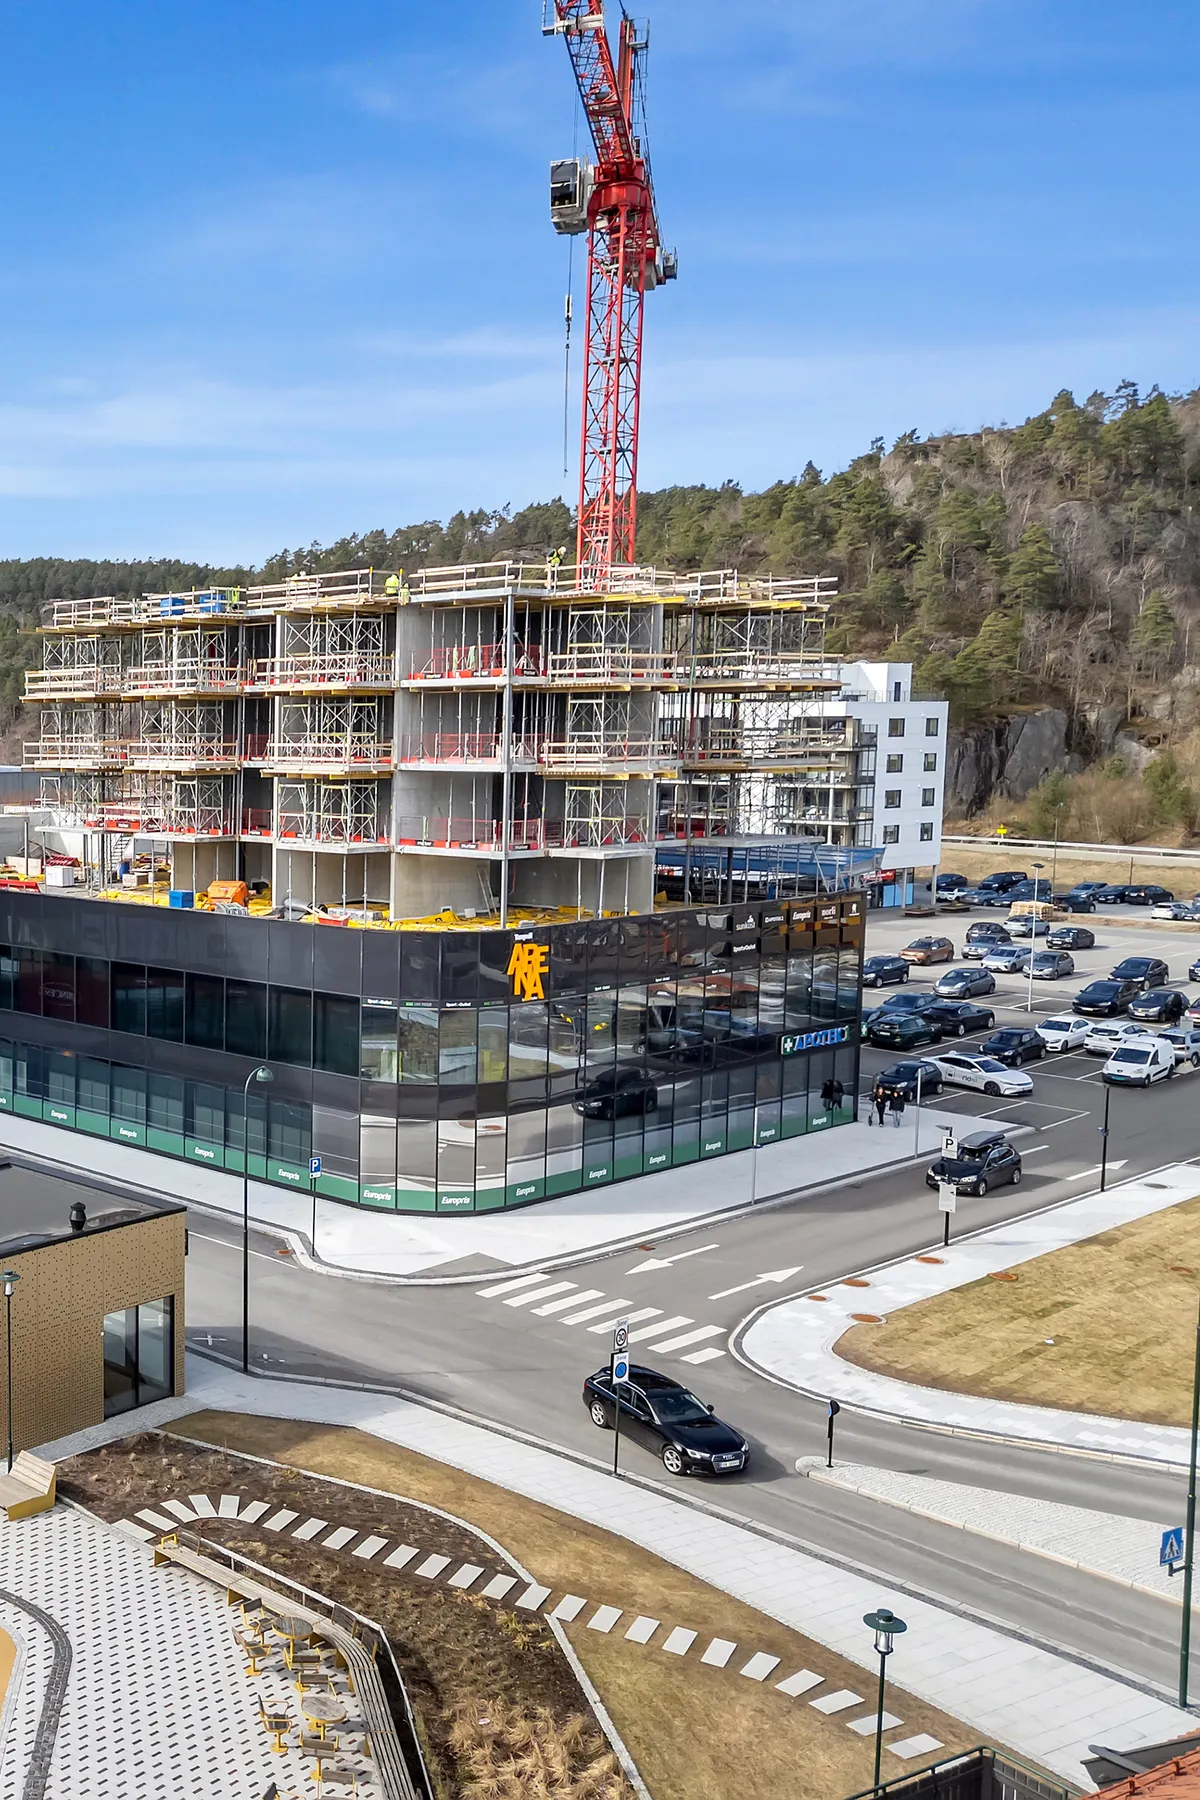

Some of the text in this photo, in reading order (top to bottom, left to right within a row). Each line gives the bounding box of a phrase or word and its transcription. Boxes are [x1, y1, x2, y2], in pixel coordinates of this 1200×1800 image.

[945, 1138, 954, 1149] P
[194, 1146, 215, 1158] Europris
[312, 1159, 319, 1171] P
[278, 1169, 300, 1180] Europris
[363, 1189, 392, 1201] Europris
[516, 1185, 536, 1196] Europris
[441, 1196, 471, 1206] Europris
